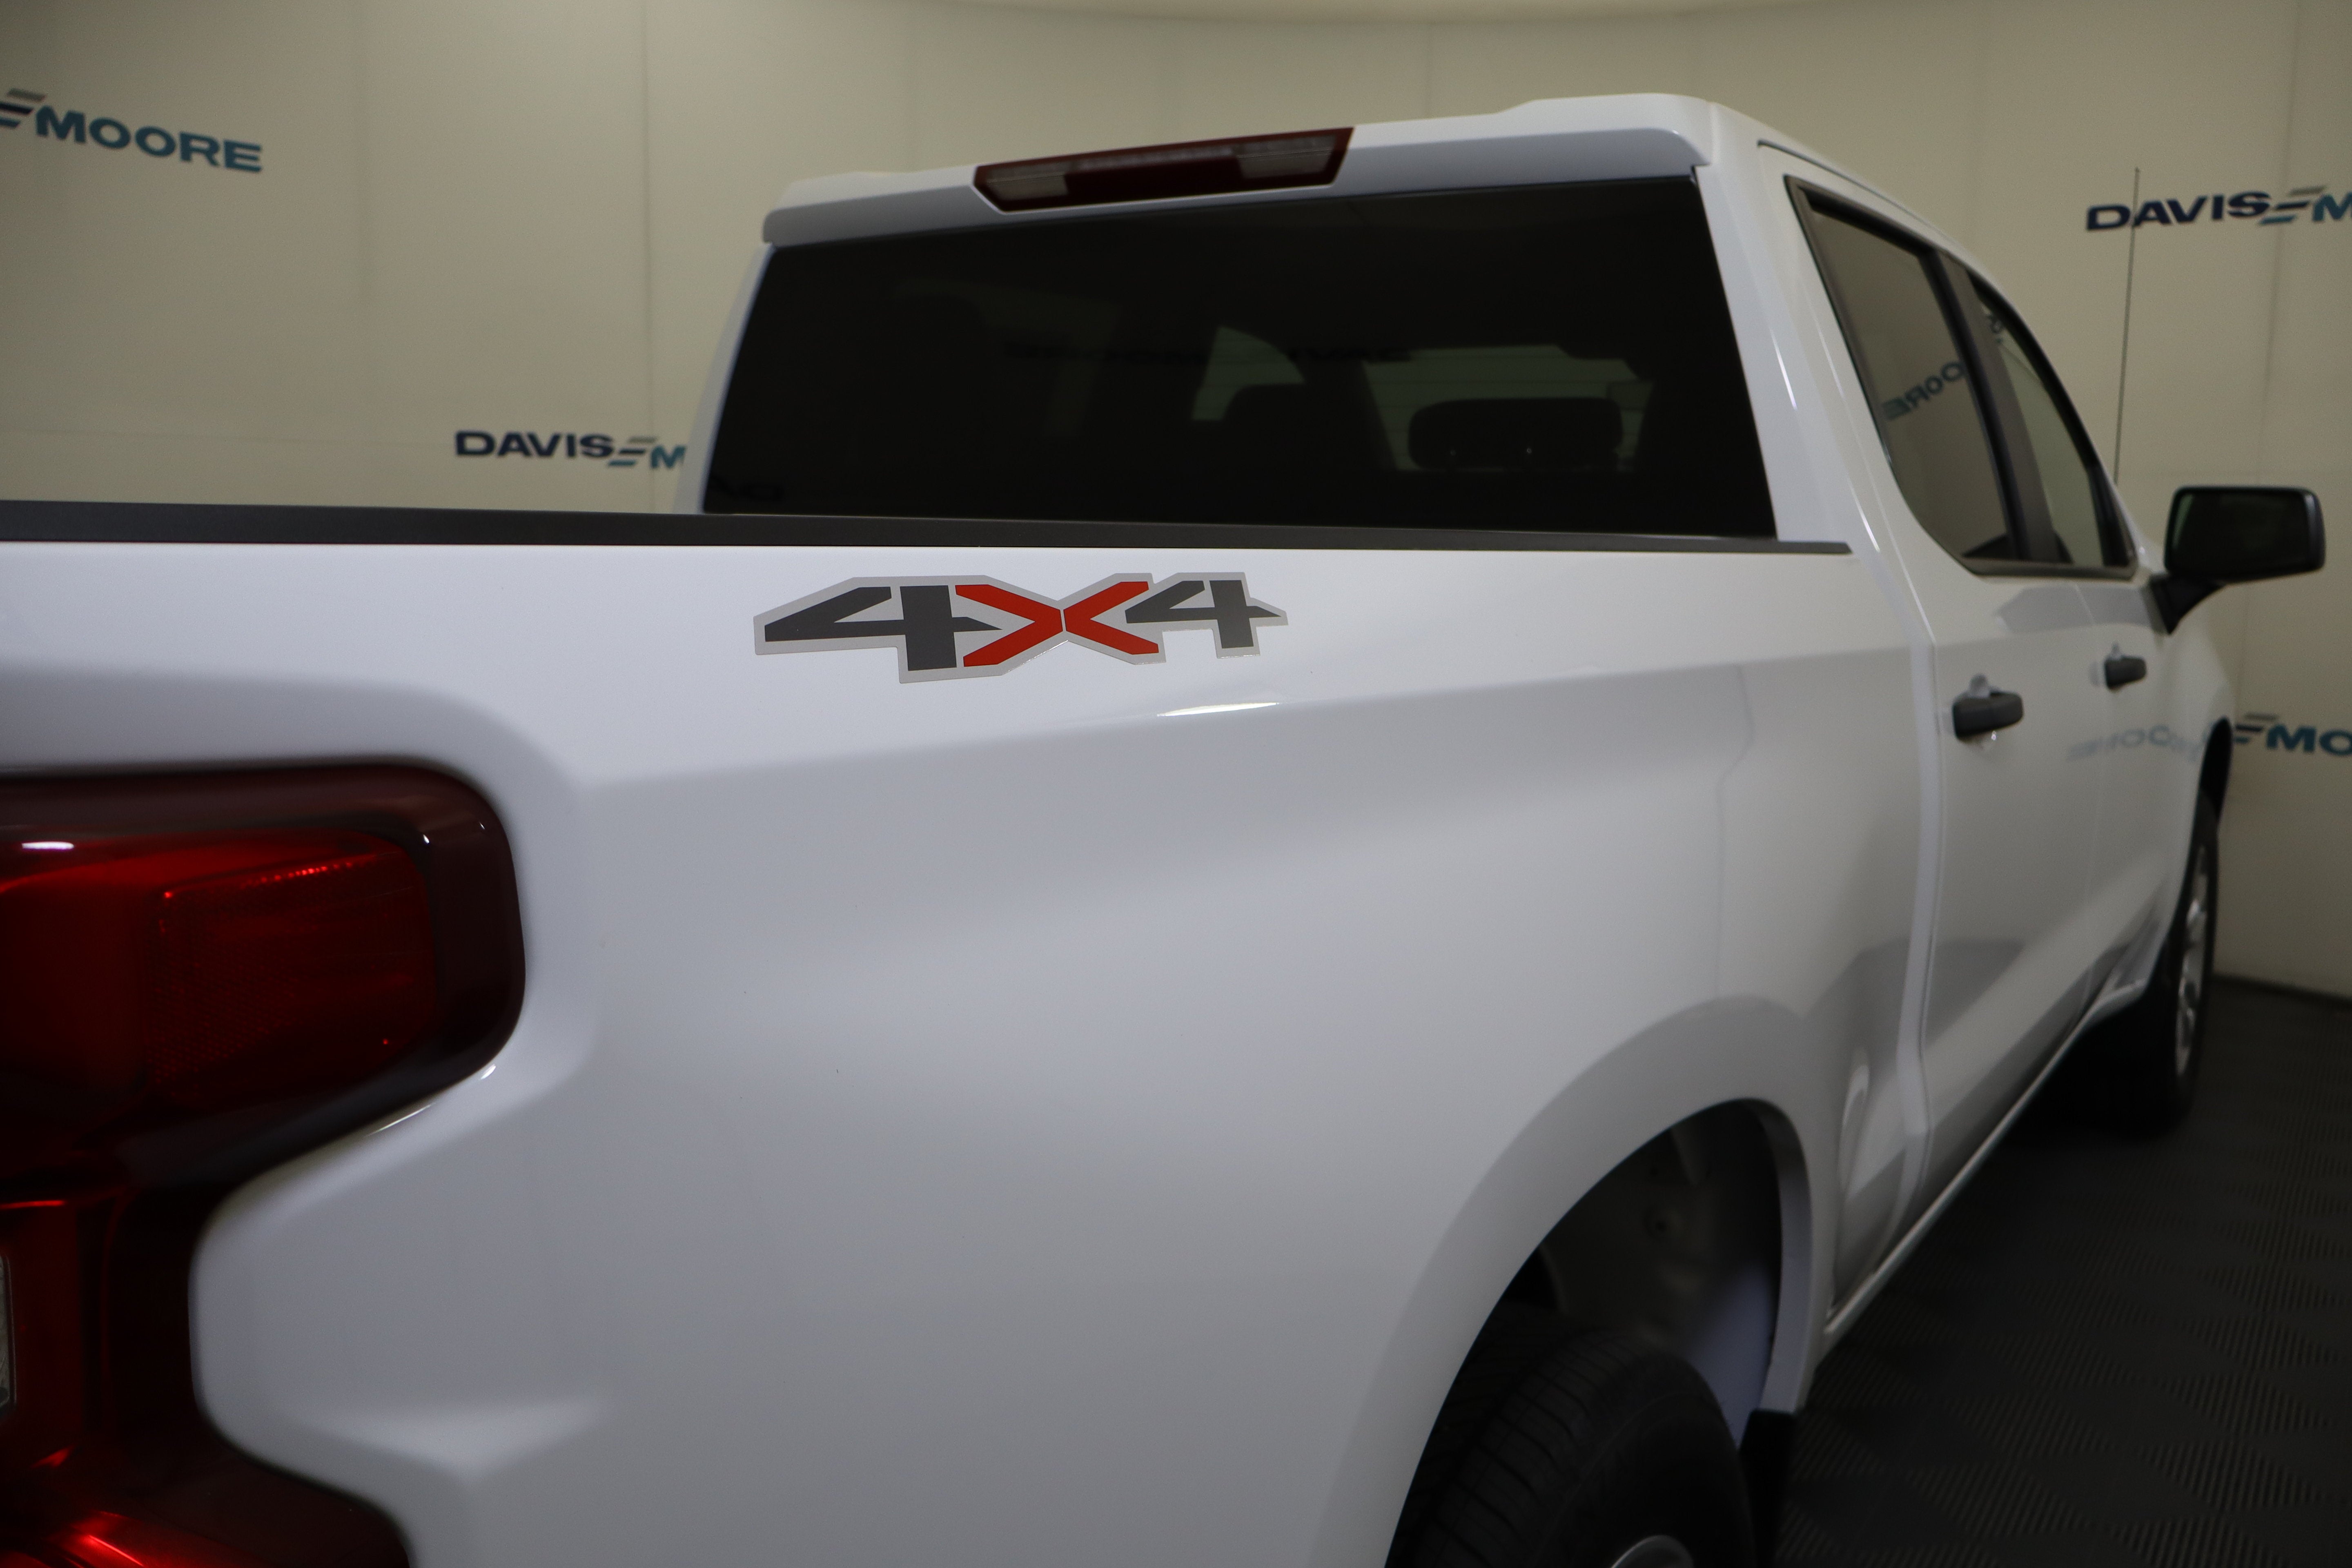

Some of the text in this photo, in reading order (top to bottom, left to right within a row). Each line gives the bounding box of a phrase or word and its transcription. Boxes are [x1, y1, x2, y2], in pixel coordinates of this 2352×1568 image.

[36, 105, 262, 173] MOORE
[2086, 191, 2272, 231] DAVIS
[455, 430, 613, 458] DAVIS
